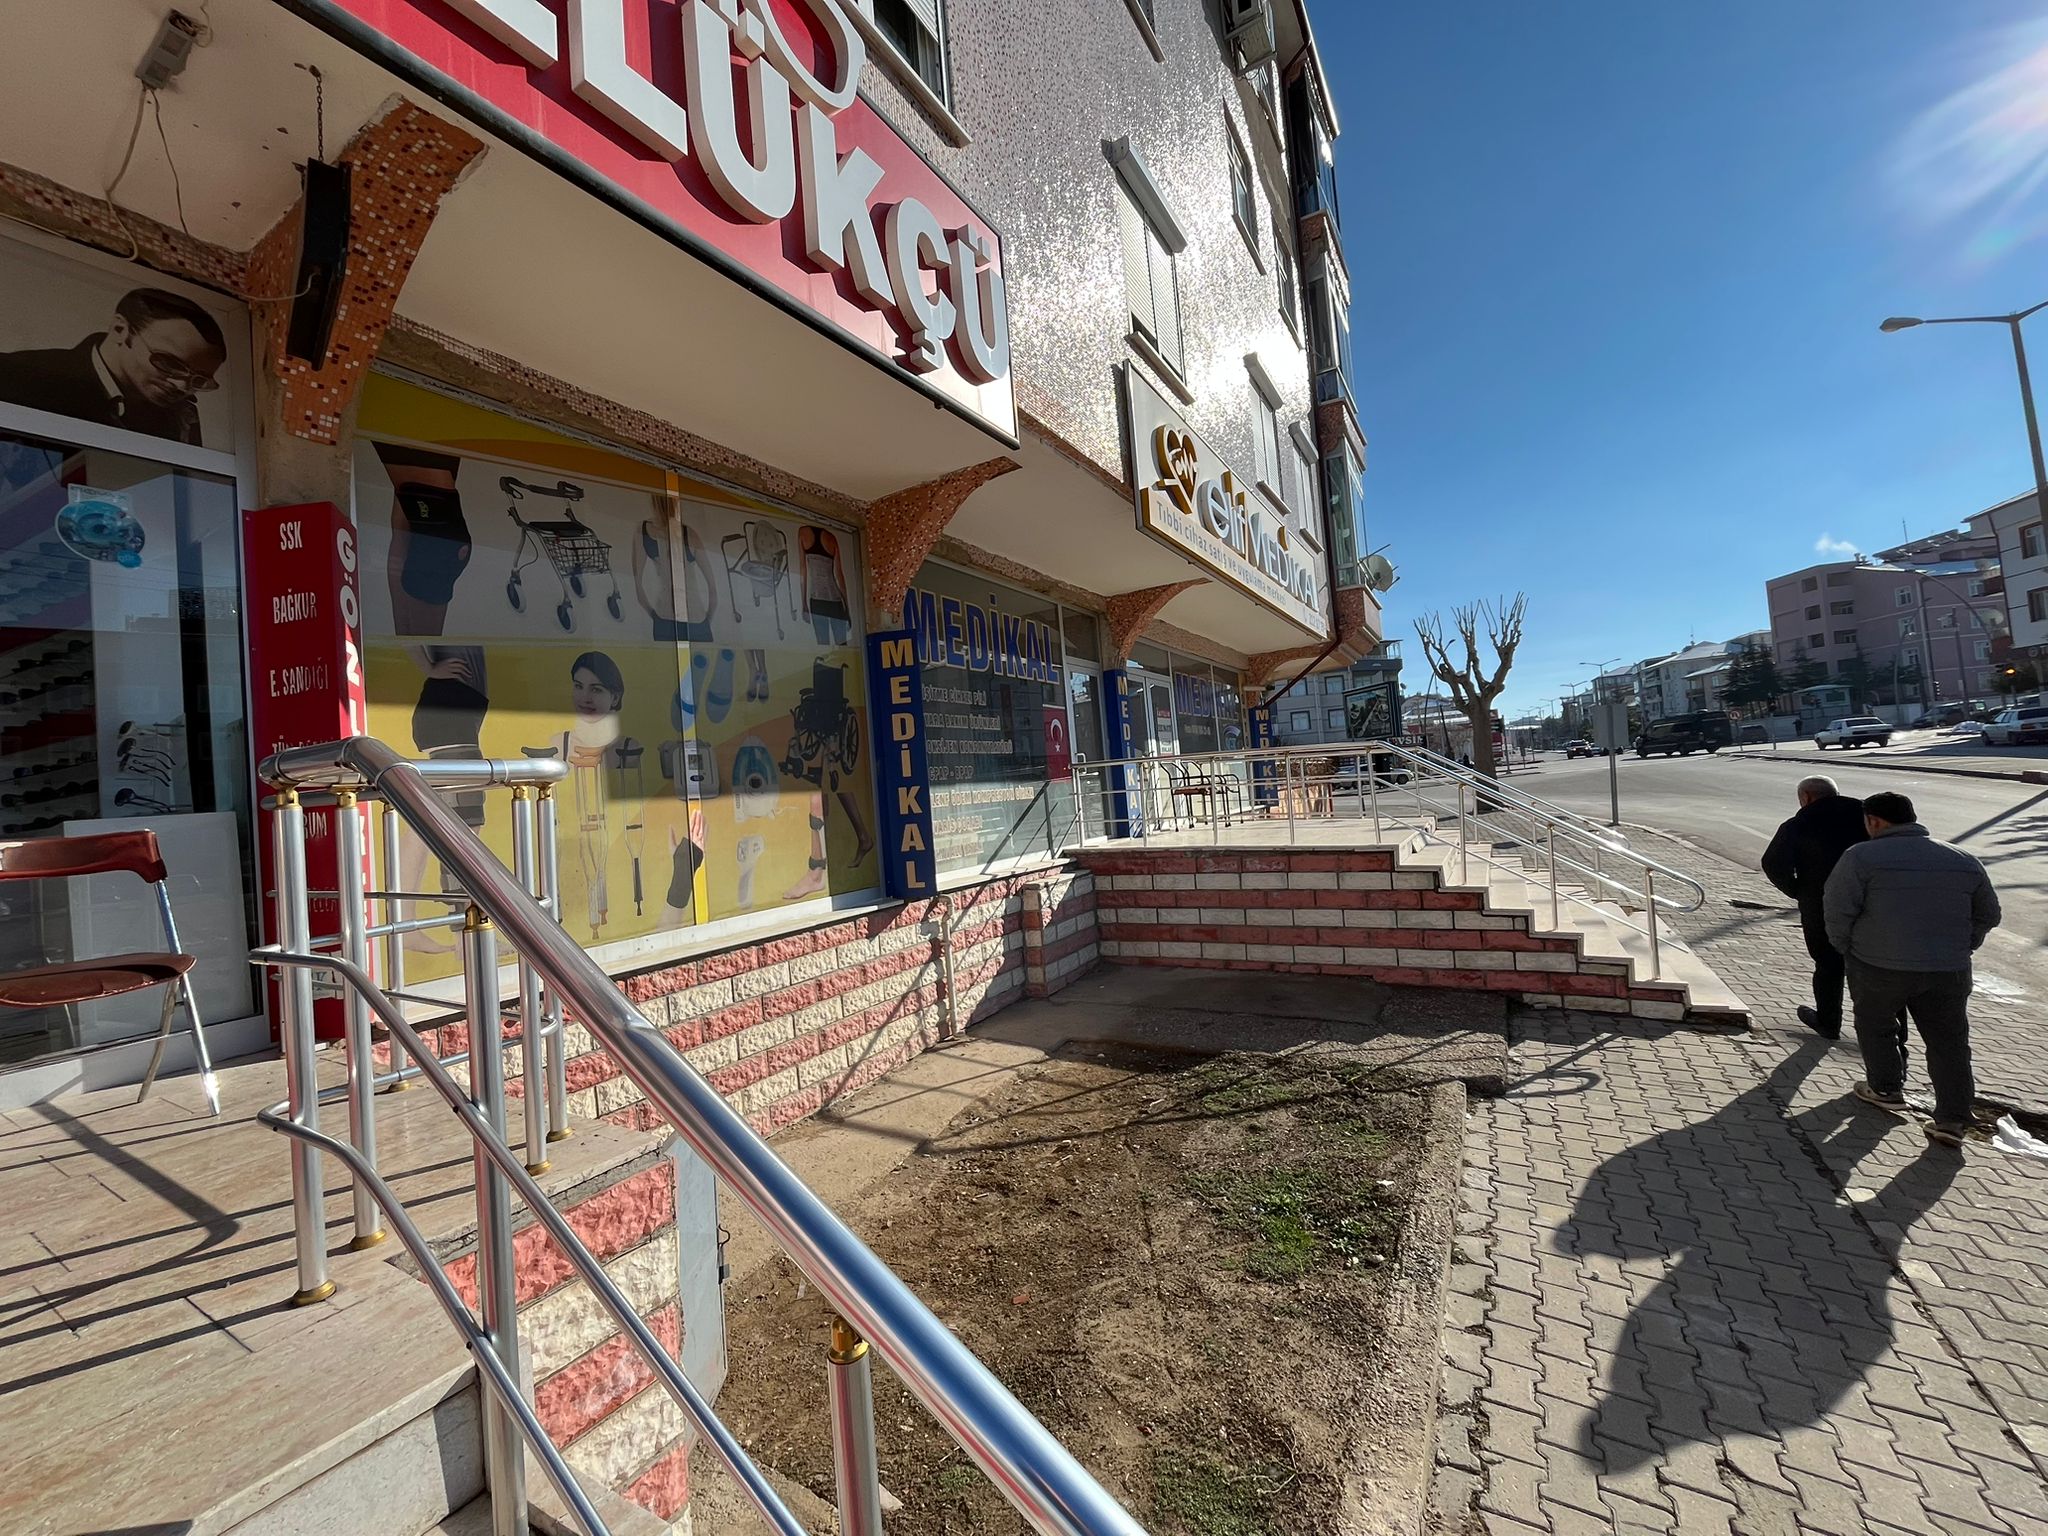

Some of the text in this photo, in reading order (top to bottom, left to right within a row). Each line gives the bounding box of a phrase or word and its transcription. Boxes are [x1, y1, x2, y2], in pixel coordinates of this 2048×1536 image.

[438, 0, 1009, 384] LÜKÇÜ
[280, 521, 302, 550] SSK
[1157, 501, 1182, 535] Tıbbi
[1185, 525, 1207, 552] cihaz
[273, 588, 317, 624] BAĞKUR
[903, 587, 1060, 685] MEDİKAL
[270, 669, 280, 698] E.
[880, 638, 926, 889] MEDİKAL
